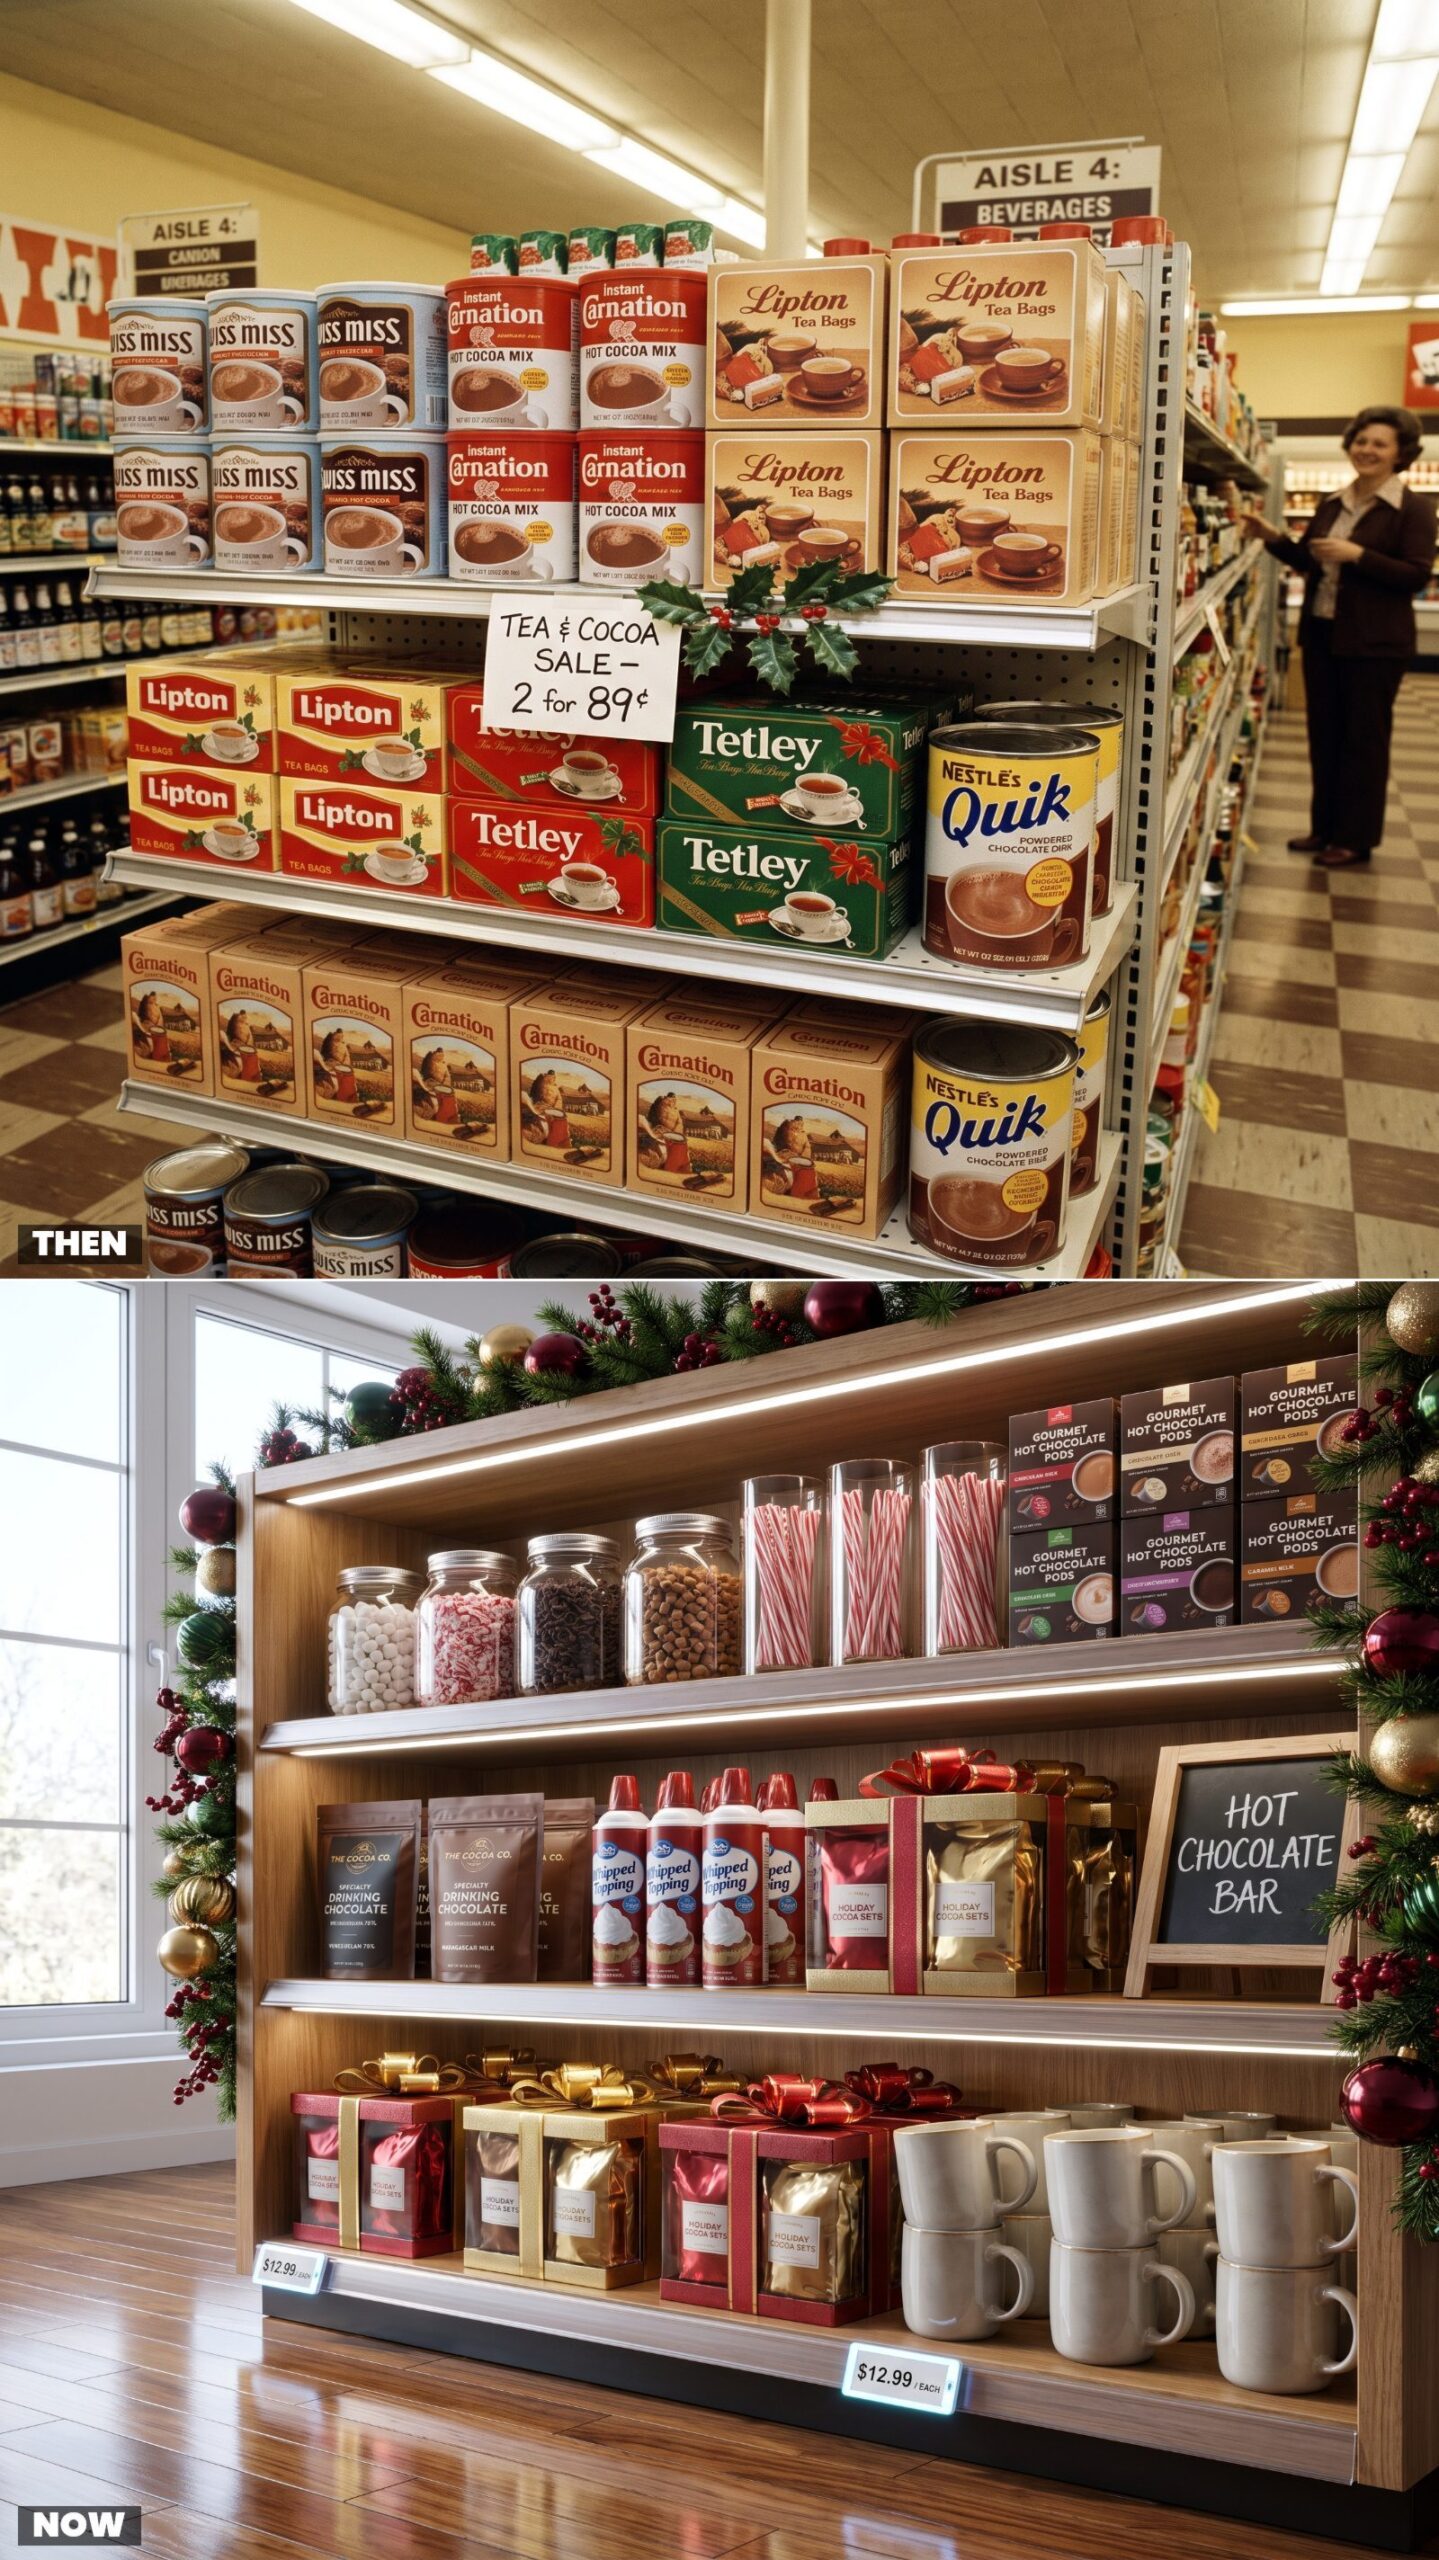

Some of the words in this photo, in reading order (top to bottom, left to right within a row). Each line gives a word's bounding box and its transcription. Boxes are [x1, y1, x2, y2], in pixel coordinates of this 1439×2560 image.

[974, 161, 1073, 189] AISLE
[1089, 157, 1120, 180] 4:
[977, 196, 1112, 226] BEVERAGES
[153, 220, 210, 242] AISLE
[218, 217, 237, 235] 4:
[463, 290, 502, 303] instant
[603, 284, 644, 297] instant
[926, 270, 1047, 303] Lipton
[583, 294, 687, 329] Carnation
[739, 284, 848, 319] Lipton
[984, 303, 1012, 317] Tea
[1017, 302, 1056, 318] Bags
[448, 301, 545, 335] Carnation
[791, 315, 817, 328] Tea
[821, 315, 857, 329] Bags
[241, 322, 295, 348] MISS
[346, 318, 401, 345] MISS
[141, 331, 193, 354] MISS
[586, 347, 601, 359] HOT
[605, 345, 648, 358] COCOA
[652, 345, 677, 358] MIX
[451, 351, 464, 363] HOT
[466, 350, 505, 363] COCOA
[510, 350, 534, 363] MIX
[467, 444, 506, 457] instant
[602, 444, 644, 457] instant
[147, 466, 199, 490] MISS
[246, 465, 299, 490] MISS
[450, 453, 549, 486] Carnation
[582, 453, 687, 487] Carnation
[737, 453, 845, 488] Lipton
[925, 453, 1046, 490] Lipton
[321, 468, 356, 491] WISS
[361, 467, 417, 493] MISS
[365, 496, 391, 504] COCOA
[789, 486, 815, 498] Tea
[818, 486, 854, 500] Bags
[982, 488, 1010, 501] Tea
[1014, 488, 1053, 503] Bags
[453, 504, 467, 515] HOT
[470, 504, 511, 516] COCOA
[515, 504, 539, 515] MIX
[585, 505, 601, 517] HOT
[605, 505, 648, 517] COCOA
[652, 506, 677, 518] MIX
[500, 613, 550, 639] TEA
[559, 616, 570, 643] &
[578, 616, 660, 646] COCOA
[534, 648, 612, 675] SALE
[147, 682, 228, 711] Lipton
[511, 682, 533, 714] 2
[542, 688, 577, 713] for
[587, 685, 649, 722] 89¢
[300, 694, 393, 726] Lipton
[135, 743, 149, 753] TEA
[151, 745, 173, 756] BAGS
[693, 721, 823, 771] Tetley
[285, 760, 303, 771] TEA
[304, 762, 329, 774] BAGS
[148, 777, 229, 809] Lipton
[303, 797, 393, 830] Lipton
[941, 774, 1071, 848] Quik
[136, 838, 151, 848] TEA
[153, 839, 175, 851] BAGS
[471, 813, 583, 861] Tetley
[1020, 834, 1073, 845] POWDERED
[988, 843, 1050, 854] CHOCOLATE
[289, 860, 305, 871] TEA
[307, 862, 332, 874] BAGS
[684, 837, 811, 890] Tetley
[129, 950, 198, 985] Carnation
[217, 968, 291, 1004] Carnation
[311, 985, 391, 1021] Carnation
[411, 1002, 494, 1042] Carnation
[519, 1023, 610, 1065] Carnation
[638, 1044, 734, 1085] Carnation
[763, 1066, 866, 1110] Carnation
[925, 1094, 1048, 1156] Quik
[966, 1156, 1026, 1167] CHOCOLATE
[995, 1147, 1049, 1159] POWDERED
[172, 1205, 219, 1227] MISS
[257, 1227, 304, 1251] MISS
[350, 1254, 394, 1277] MISS
[1270, 1382, 1334, 1402] GOURMET
[1146, 1403, 1206, 1423] GOURMET
[1248, 1404, 1274, 1417] HOT
[1277, 1390, 1357, 1413] CHOCOLATE
[1127, 1425, 1150, 1438] HOT
[1153, 1412, 1227, 1433] CHOCOLATE
[1284, 1408, 1319, 1423] PODS
[1032, 1424, 1088, 1442] GOURMET
[1160, 1429, 1192, 1443] PODS
[1014, 1444, 1036, 1456] HOT
[1038, 1432, 1106, 1452] CHOCOLATE
[1044, 1449, 1074, 1463] PODS
[1269, 1515, 1334, 1533] GOURMET
[1146, 1532, 1206, 1549] GOURMET
[1248, 1535, 1274, 1548] HOT
[1277, 1525, 1357, 1544] CHOCOLATE
[1032, 1547, 1088, 1563] GOURMET
[1127, 1551, 1150, 1562] HOT
[1153, 1541, 1227, 1559] CHOCOLATE
[1283, 1541, 1319, 1554] PODS
[1014, 1564, 1035, 1576] HOT
[1038, 1556, 1107, 1572] CHOCOLATE
[1160, 1556, 1193, 1569] PODS
[1044, 1570, 1075, 1583] PODS
[1224, 1791, 1299, 1829] HOT
[331, 1854, 345, 1863] THE
[346, 1854, 376, 1863] COCOA
[378, 1853, 392, 1862] CO.
[445, 1852, 460, 1861] THE
[462, 1851, 494, 1860] COCOA
[496, 1850, 512, 1859] CO.
[1177, 1834, 1336, 1872] CHOCOLATE
[703, 1859, 748, 1880] Whipped
[443, 1891, 500, 1902] DRINKING
[704, 1878, 747, 1895] Topping
[1208, 1878, 1283, 1915] BAR
[328, 1892, 381, 1903] DRINKING
[838, 1903, 875, 1912] HOLIDAY
[942, 1903, 981, 1912] HOLIDAY
[324, 1903, 388, 1915] CHOCOLATE
[438, 1903, 507, 1914] CHOCOLATE
[832, 1912, 859, 1921] COCOA
[860, 1912, 884, 1921] SETS
[936, 1912, 965, 1921] COCOA
[966, 1912, 989, 1921] SETS
[685, 2228, 709, 2238] COCOA
[709, 2231, 728, 2239] SETS
[689, 2221, 722, 2231] HOLIDAY
[770, 2240, 795, 2250] COCOA
[796, 2243, 816, 2253] SETS
[774, 2232, 810, 2243] HOLIDAY
[263, 2258, 297, 2276] $12.99
[858, 2363, 913, 2387] $12.99
[919, 2383, 941, 2393] EACH
